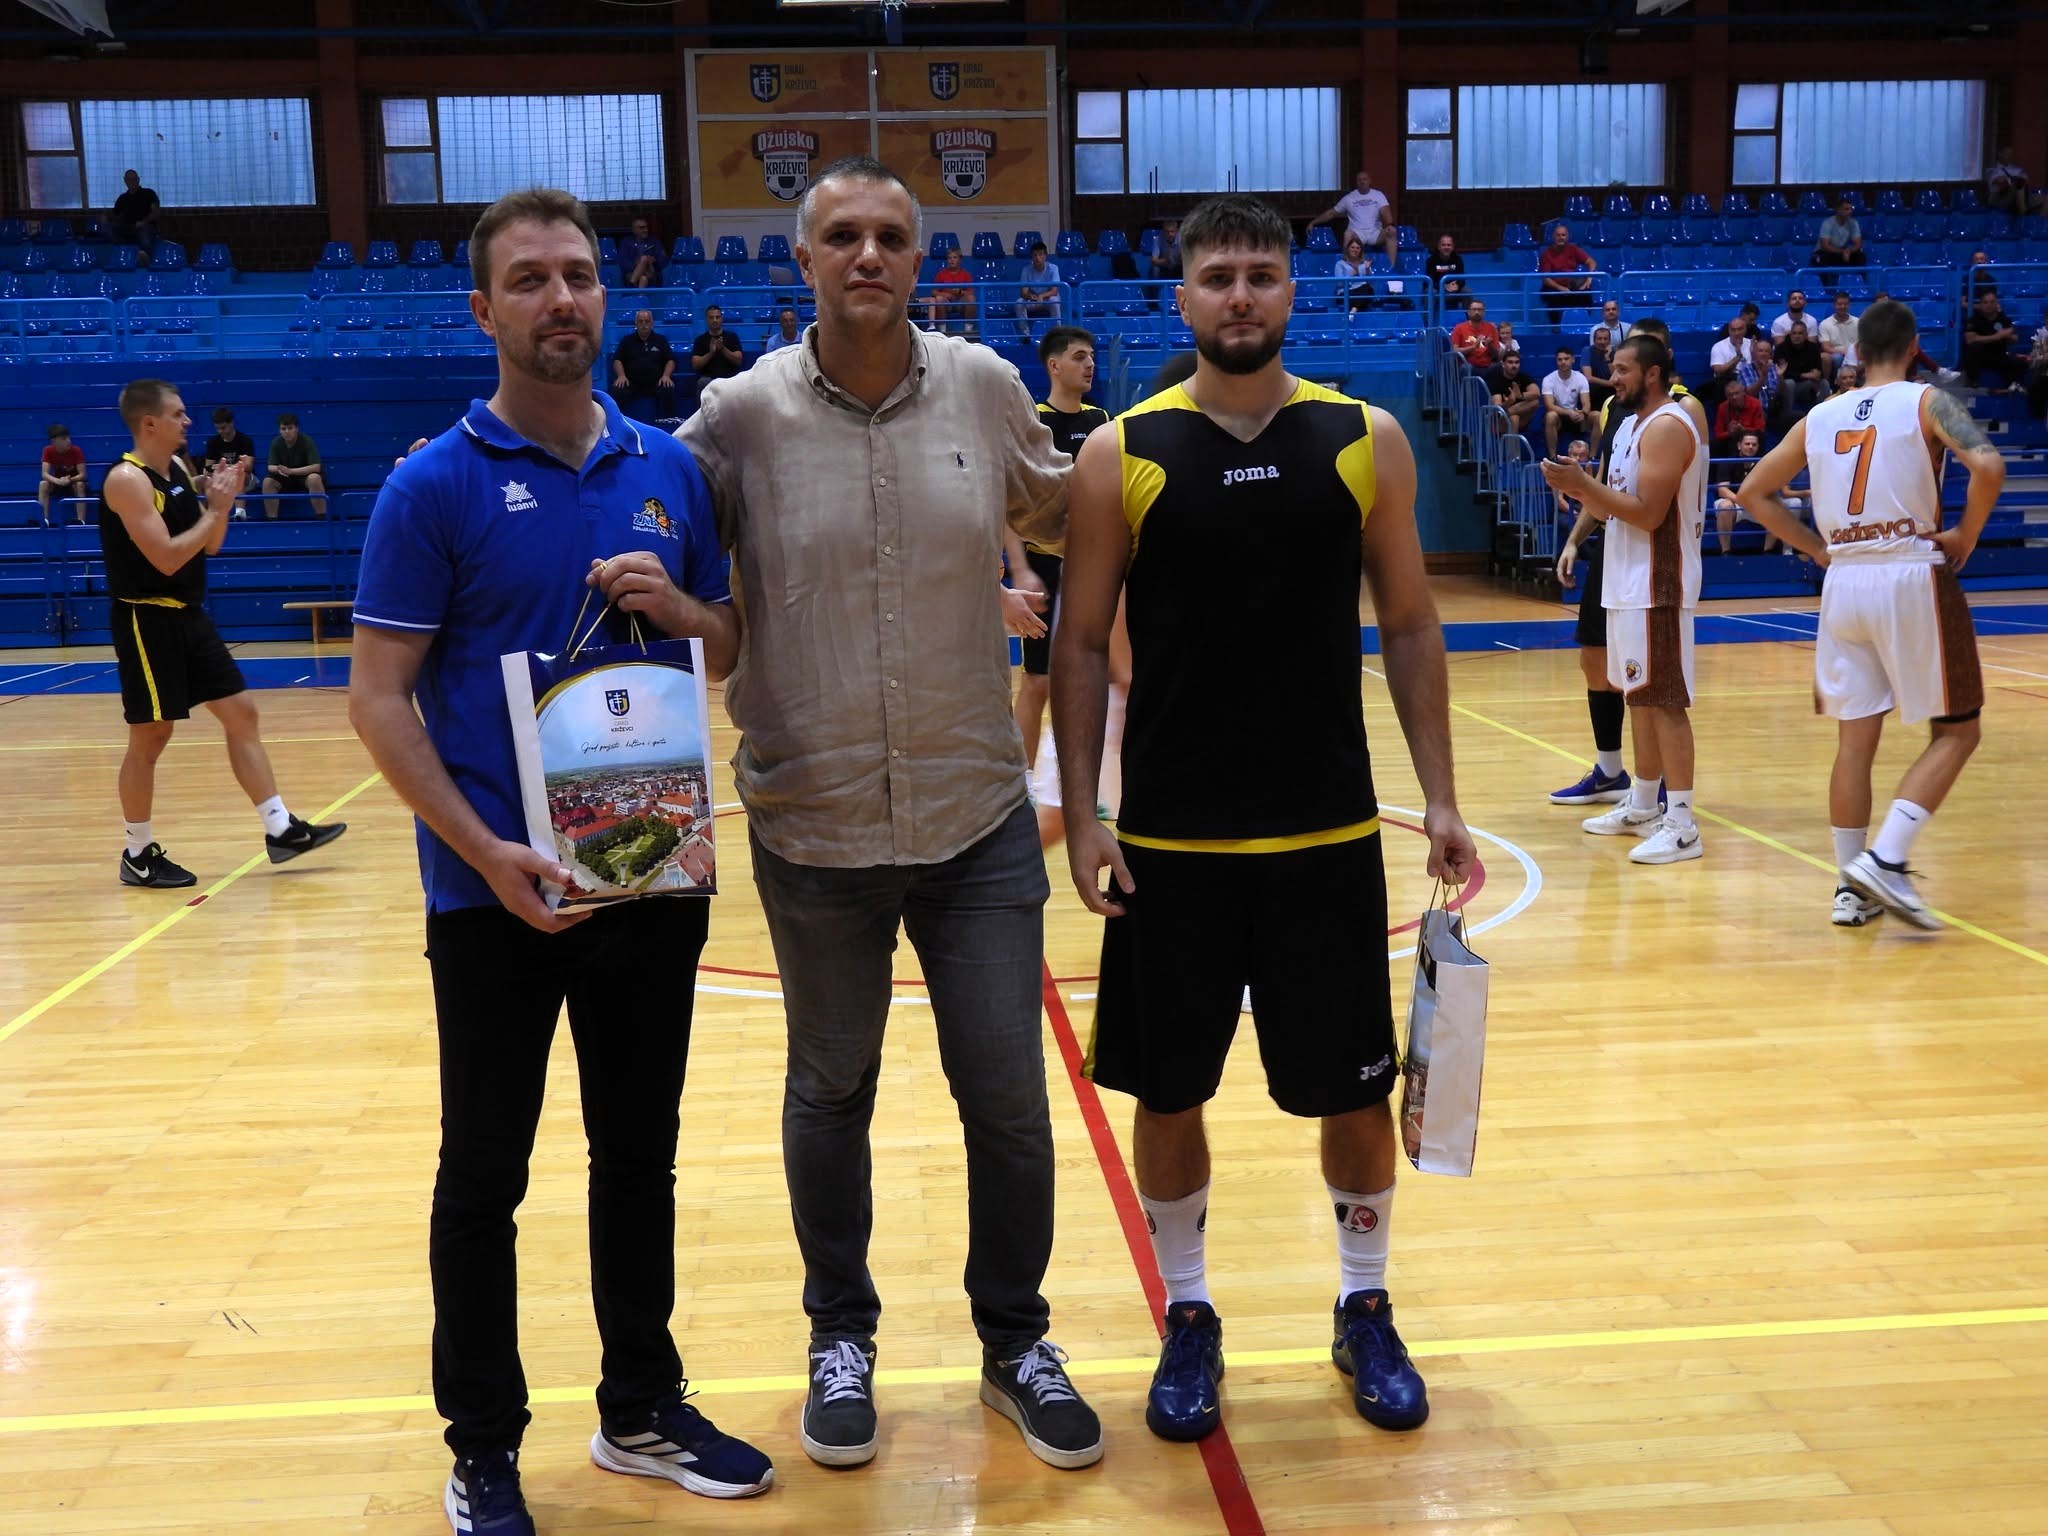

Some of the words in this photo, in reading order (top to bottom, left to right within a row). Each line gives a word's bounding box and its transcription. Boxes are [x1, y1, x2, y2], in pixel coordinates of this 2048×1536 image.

[757, 129, 814, 151] Ožujsko
[936, 128, 992, 150] Ožujsko
[766, 159, 807, 175] KRIŽEVCI
[944, 158, 985, 173] KRIŽEVCI
[1835, 424, 1877, 515] 7
